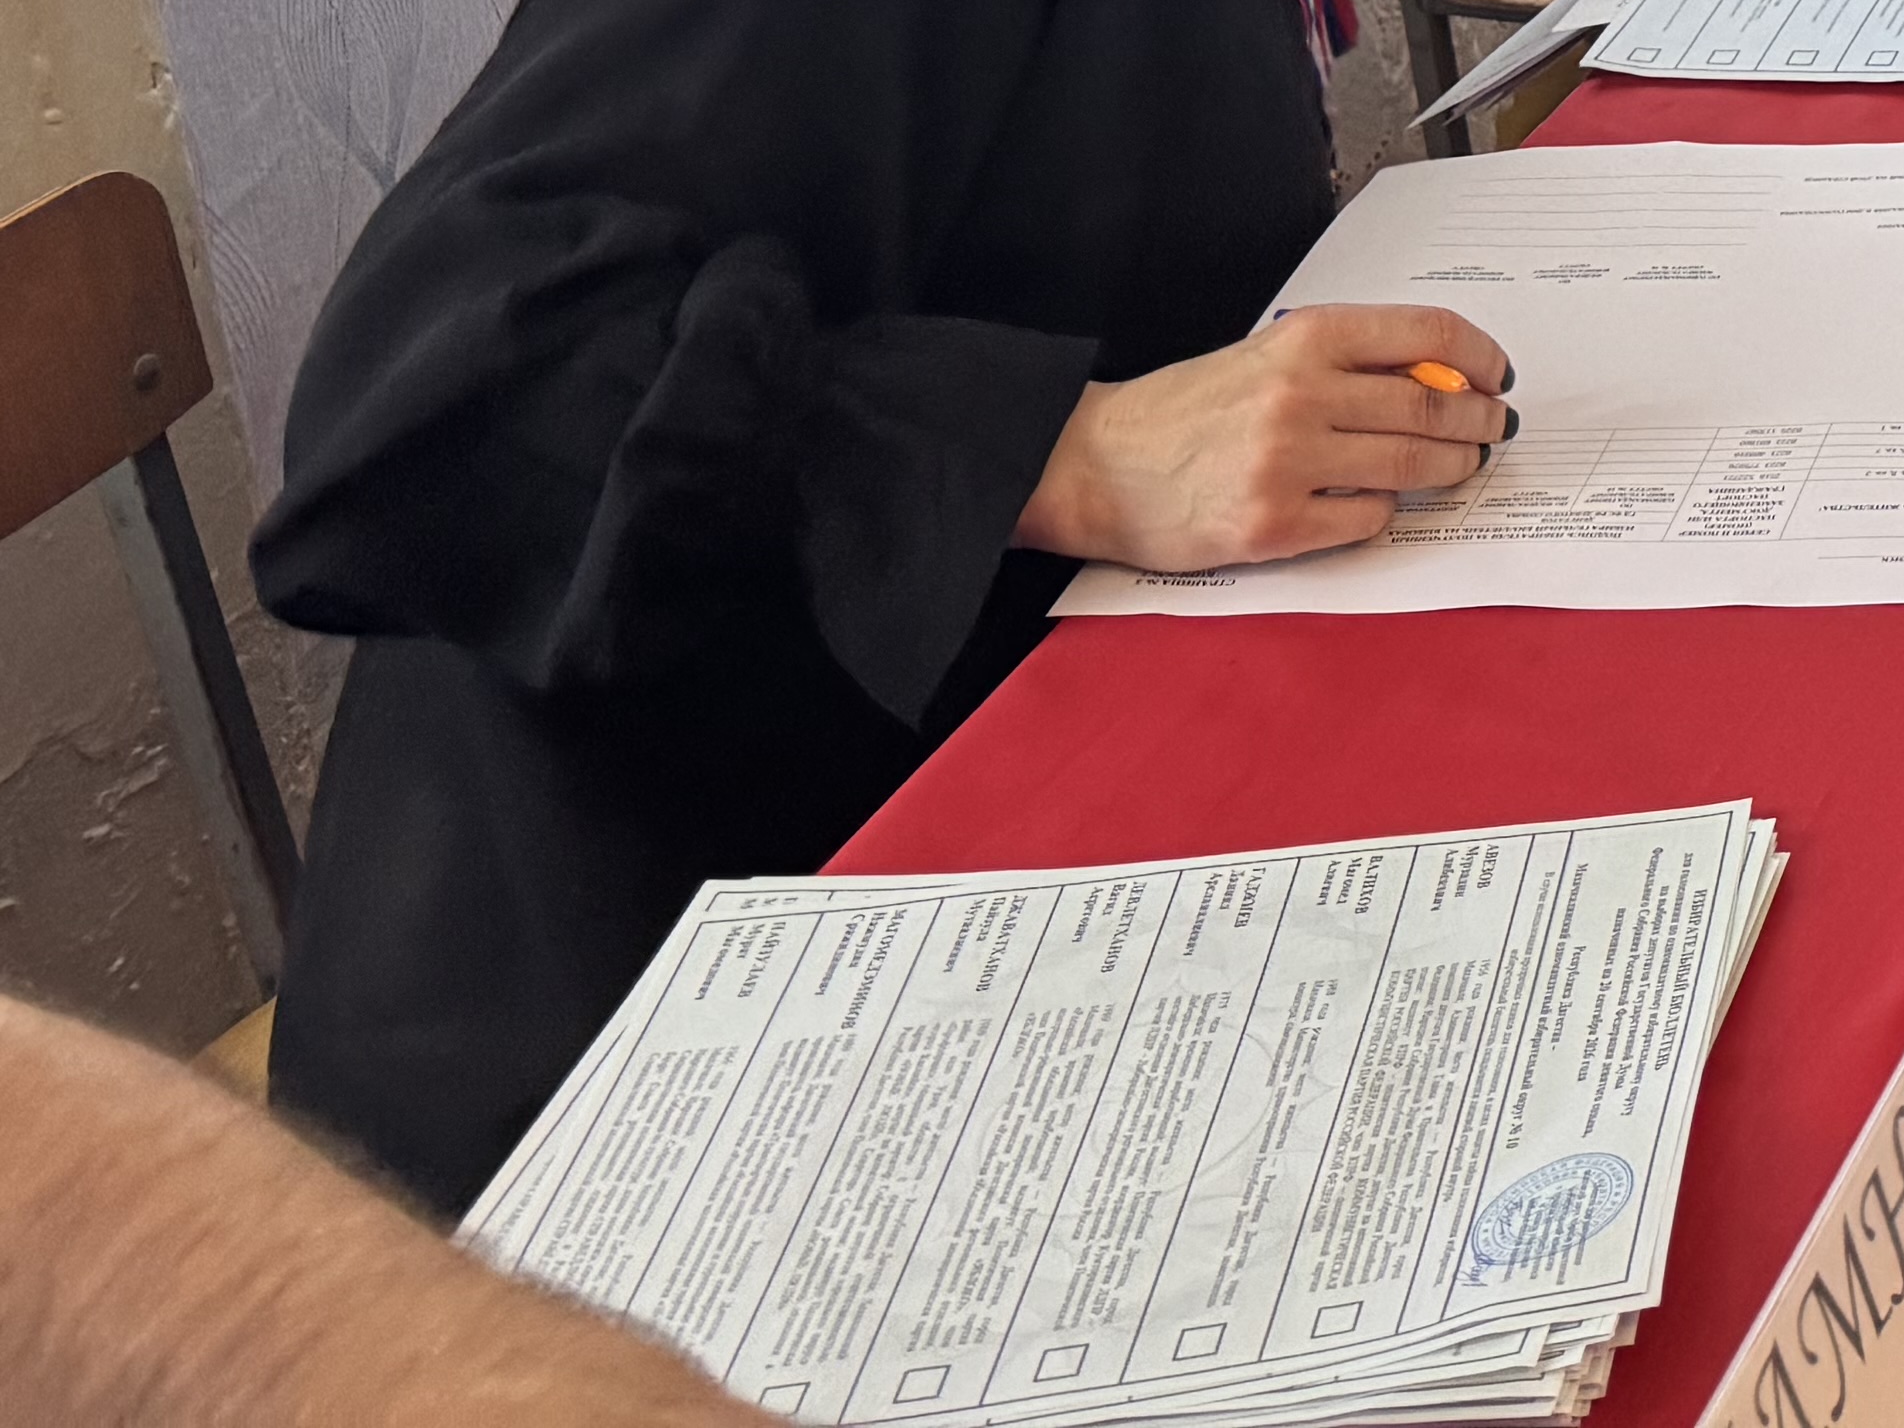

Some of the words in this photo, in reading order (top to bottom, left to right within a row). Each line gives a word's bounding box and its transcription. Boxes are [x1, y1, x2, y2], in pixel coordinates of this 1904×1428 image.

[1233, 867, 1266, 928] ГАДЖИЕВ
[1354, 855, 1384, 914] ВАЛИХОВ
[1476, 844, 1500, 889] АВЕЗОВ
[737, 921, 786, 998] ПАЙЗУЛАЕВ
[975, 895, 1028, 992] ДЖАВАТХАНОВ
[1100, 882, 1148, 973] ДЕВЛЕТХАНОВ
[1670, 887, 1710, 993] ИЗБИРАТЕЛЬНЫЙ
[1652, 993, 1684, 1072] БЮЛЛЕТЕНЬ
